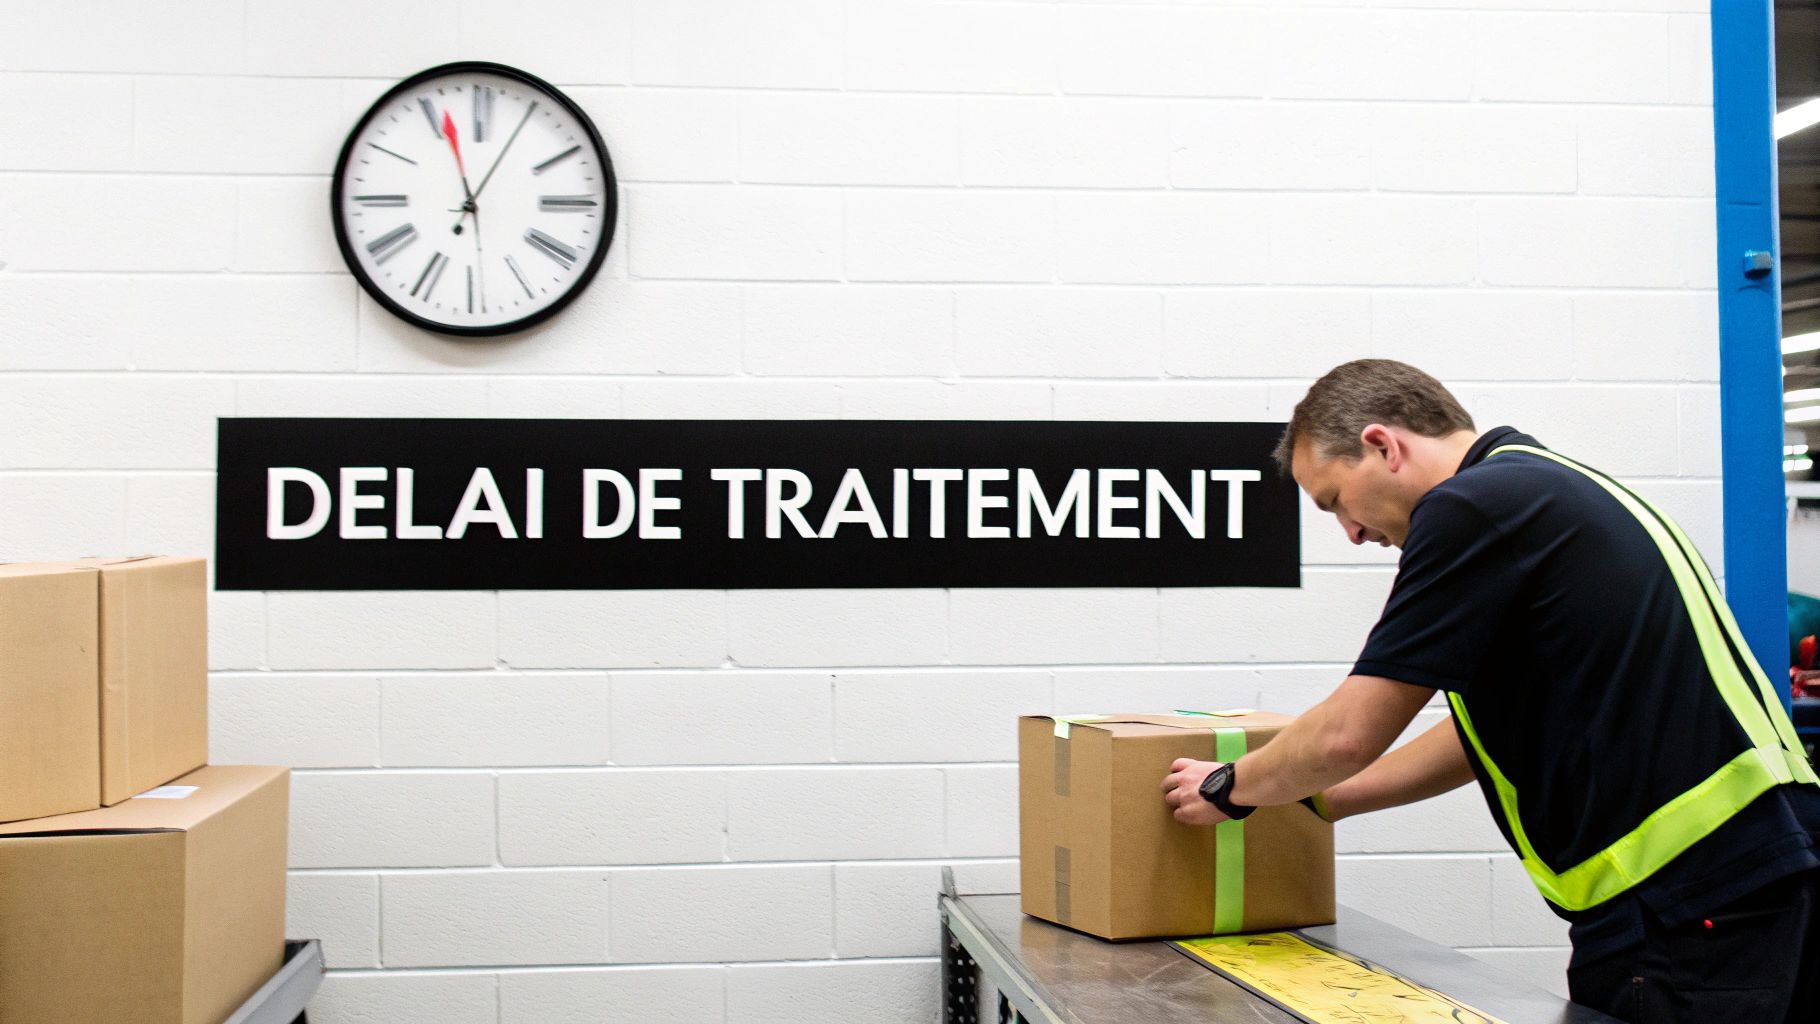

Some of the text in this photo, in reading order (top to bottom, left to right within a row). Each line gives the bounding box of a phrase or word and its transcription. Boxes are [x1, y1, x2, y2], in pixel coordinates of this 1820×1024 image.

[267, 467, 1261, 539] DELAI DE TRAITEMENT
